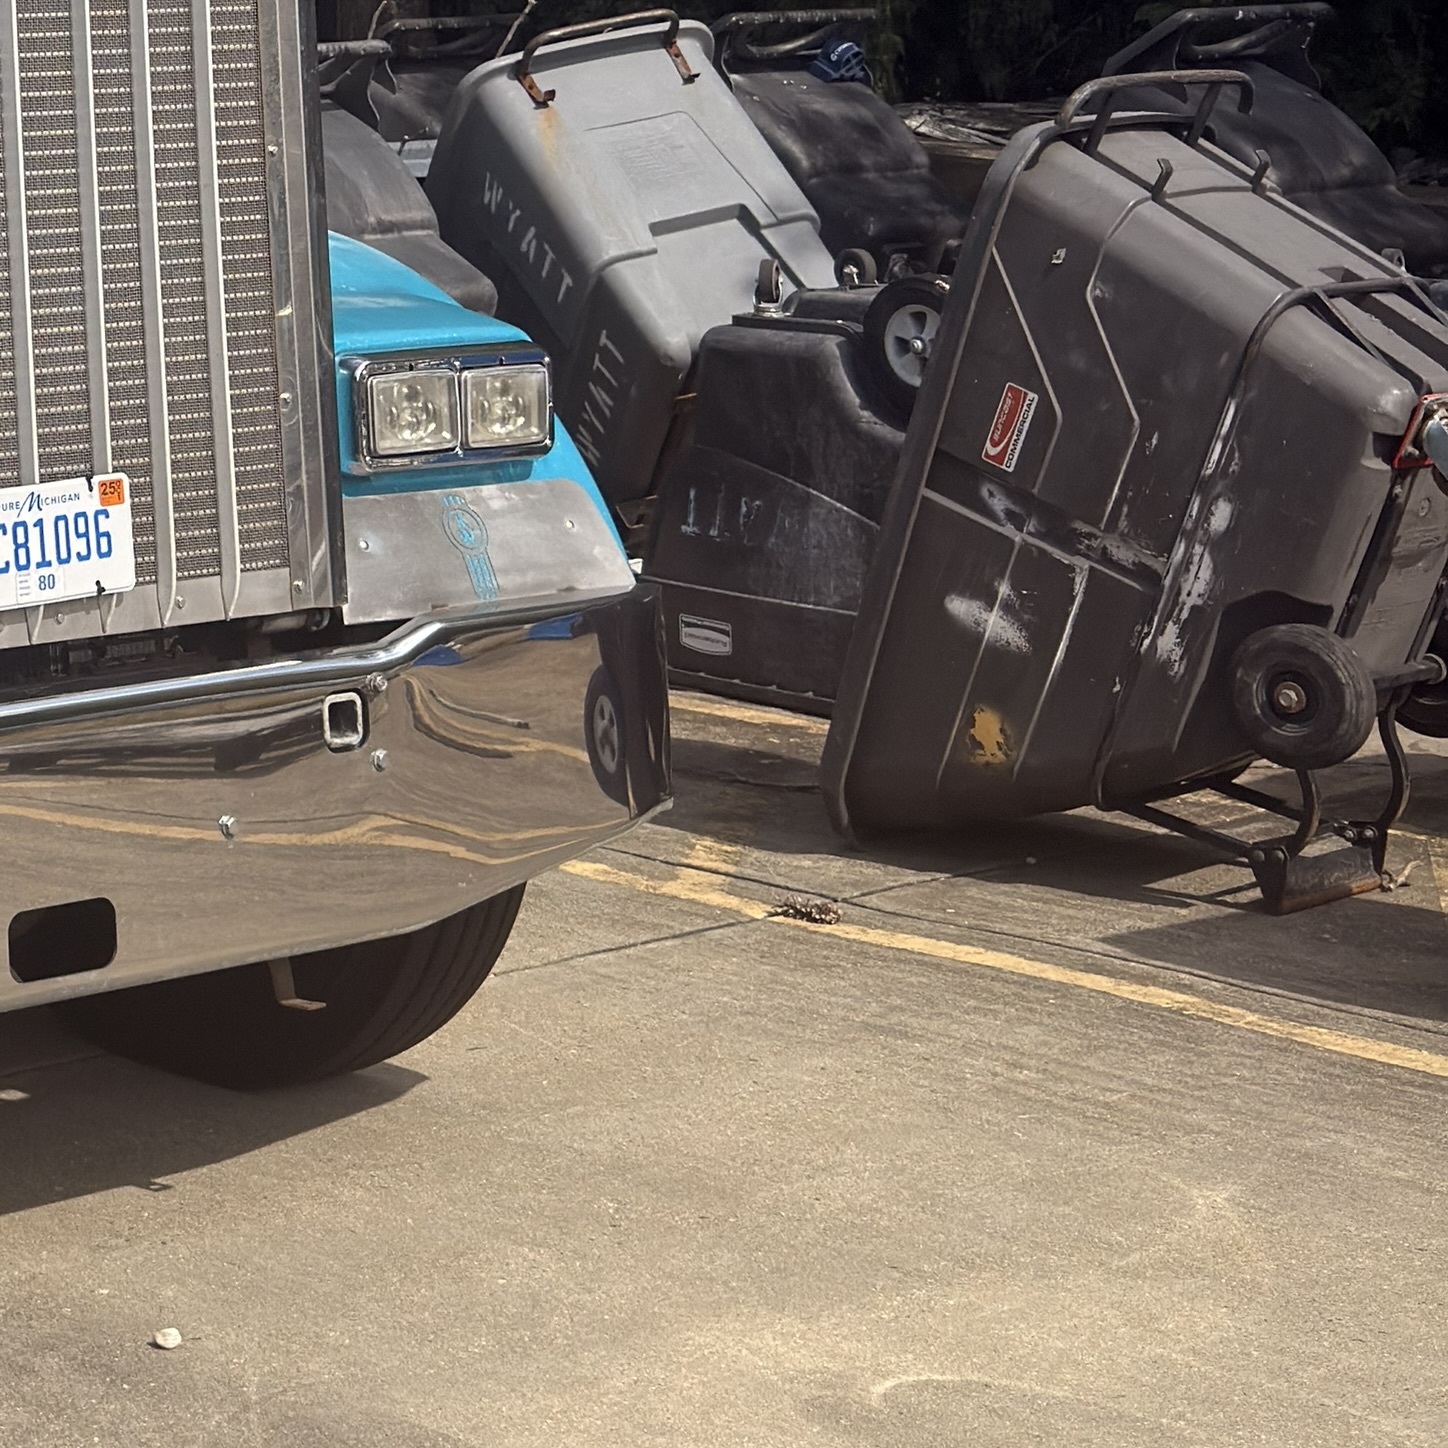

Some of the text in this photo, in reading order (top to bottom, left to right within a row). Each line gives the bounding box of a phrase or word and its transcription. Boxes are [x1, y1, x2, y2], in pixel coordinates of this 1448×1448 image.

[483, 171, 573, 303] WYATT
[576, 329, 625, 467] WYATT
[1005, 396, 1036, 469] COMMERCIAL
[100, 481, 116, 497] 25
[38, 573, 56, 591] 80
